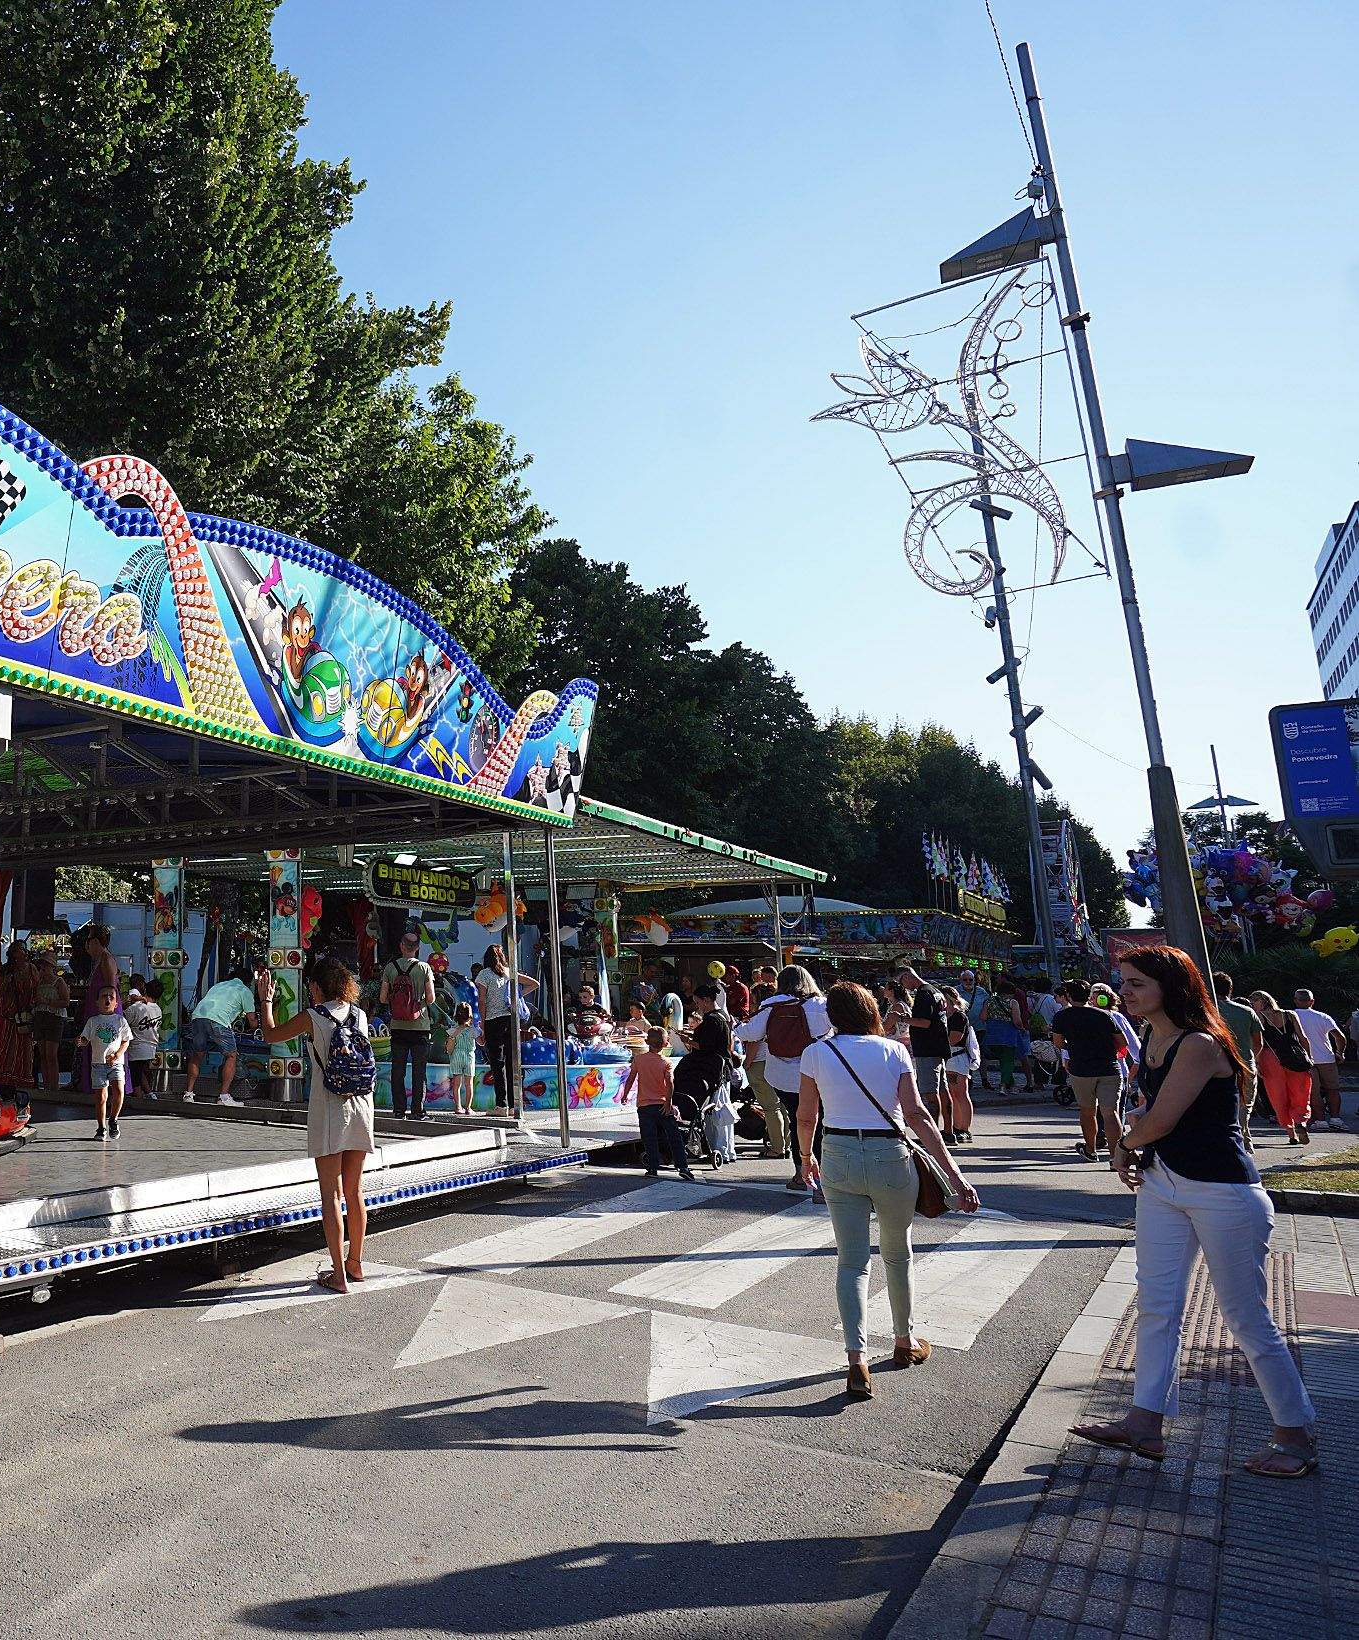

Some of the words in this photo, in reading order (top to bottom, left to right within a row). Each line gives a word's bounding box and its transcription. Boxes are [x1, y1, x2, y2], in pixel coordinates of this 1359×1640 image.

[1291, 754, 1339, 763] Pontevedra
[377, 863, 470, 891] BIENVENIDOS
[391, 881, 402, 896] A
[408, 884, 456, 903] BORDO
